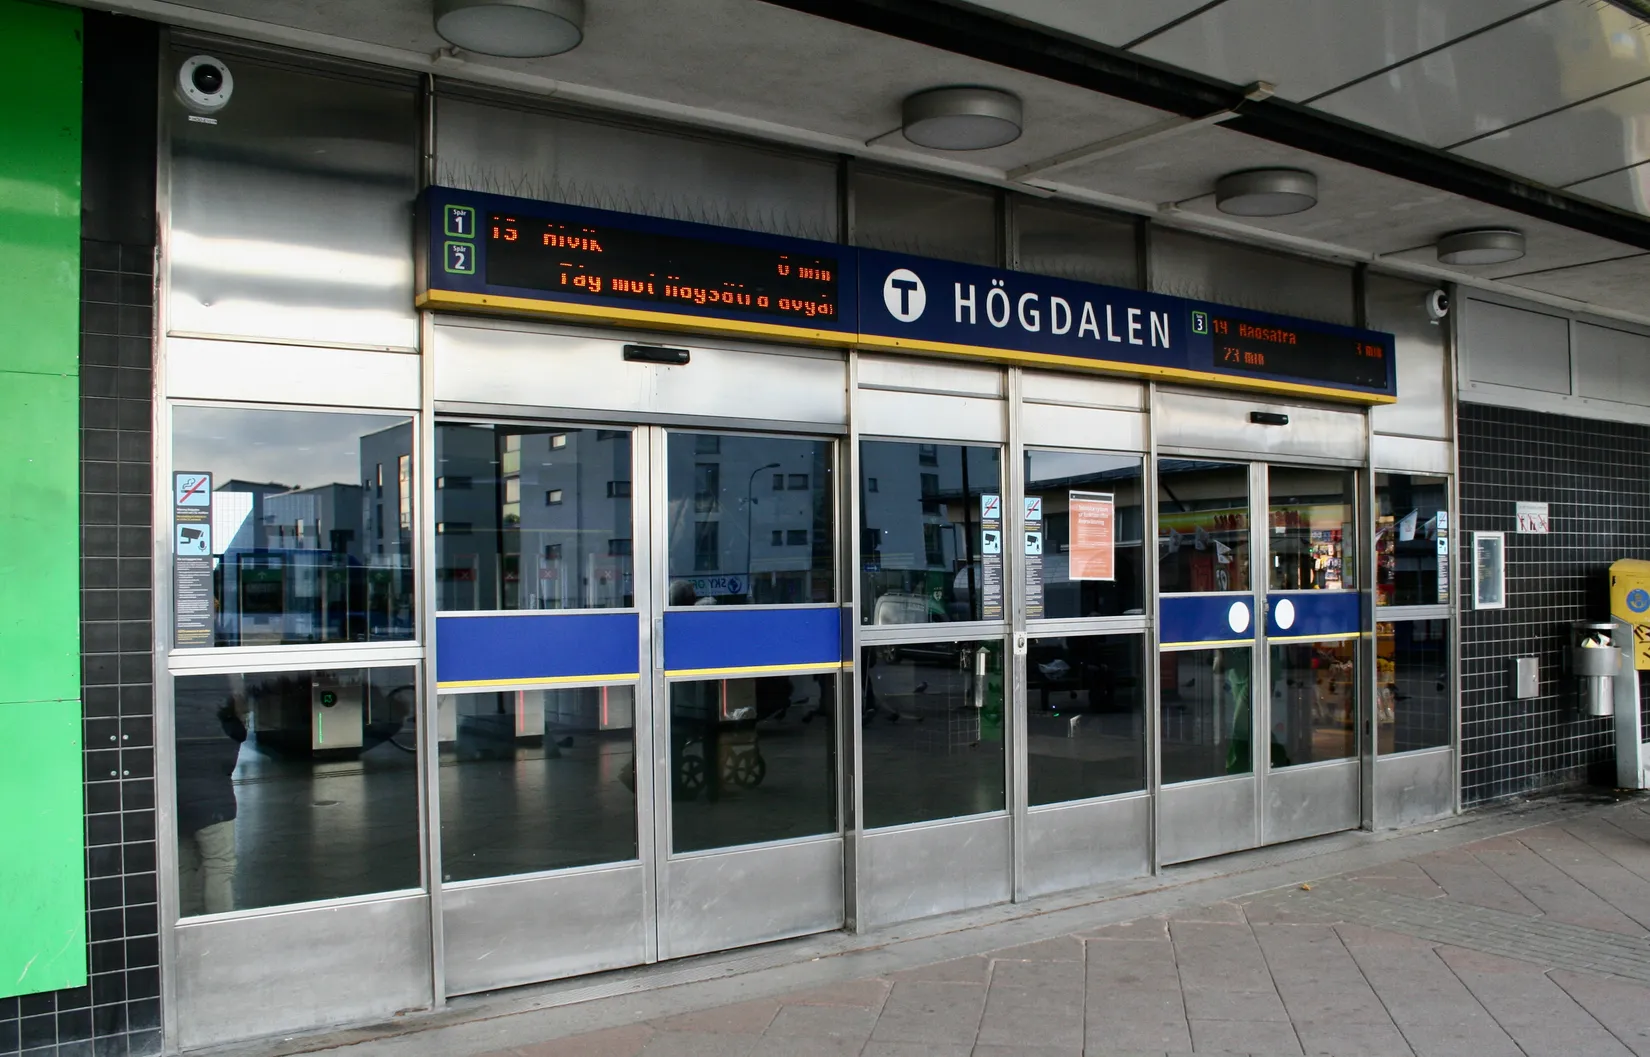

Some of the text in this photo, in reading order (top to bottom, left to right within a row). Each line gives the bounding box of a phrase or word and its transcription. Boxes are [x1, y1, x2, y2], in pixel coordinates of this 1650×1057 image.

[455, 216, 463, 233] 1
[453, 245, 467, 253] Spår
[454, 252, 465, 270] 2
[892, 278, 918, 316] T
[954, 279, 1170, 349] HÖGDALEN
[1197, 318, 1203, 331] 3
